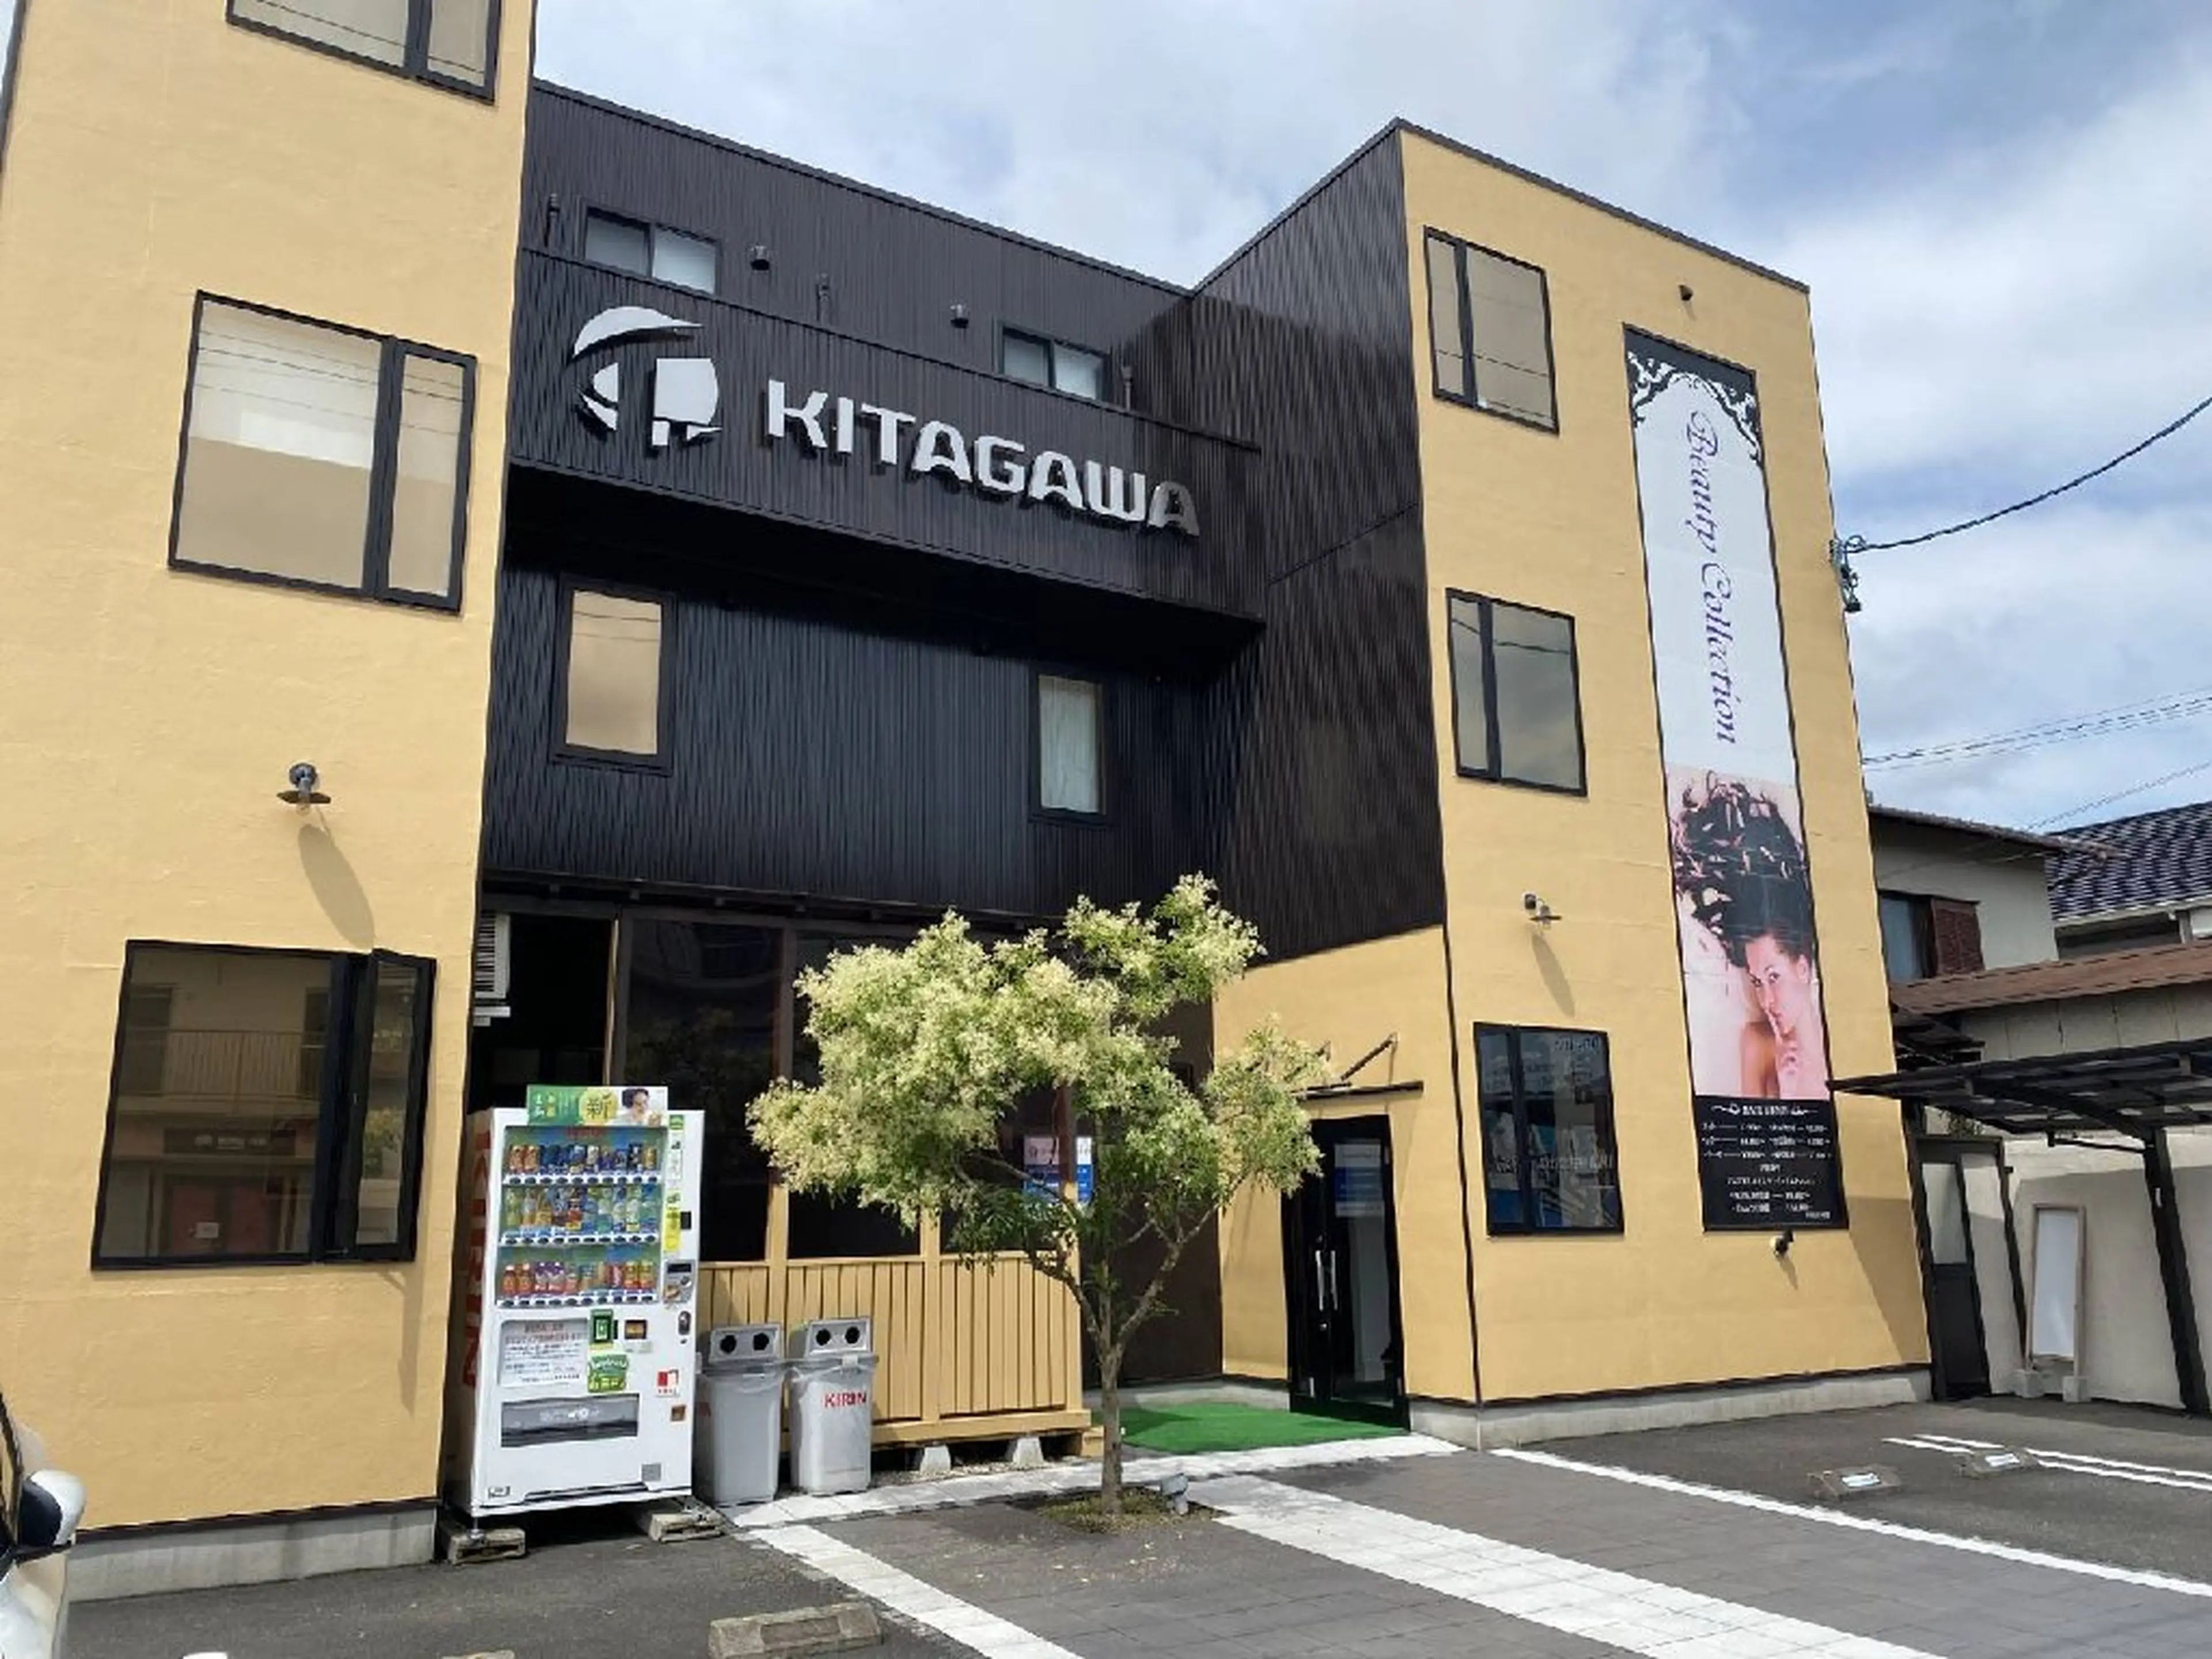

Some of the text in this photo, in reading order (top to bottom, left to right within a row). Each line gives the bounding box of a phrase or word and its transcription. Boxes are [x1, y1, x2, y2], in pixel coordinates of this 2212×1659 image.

[768, 378, 1200, 537] KITAGAWA
[1685, 410, 1741, 743] Beauty Collection
[824, 1392, 866, 1408] KIRIN
